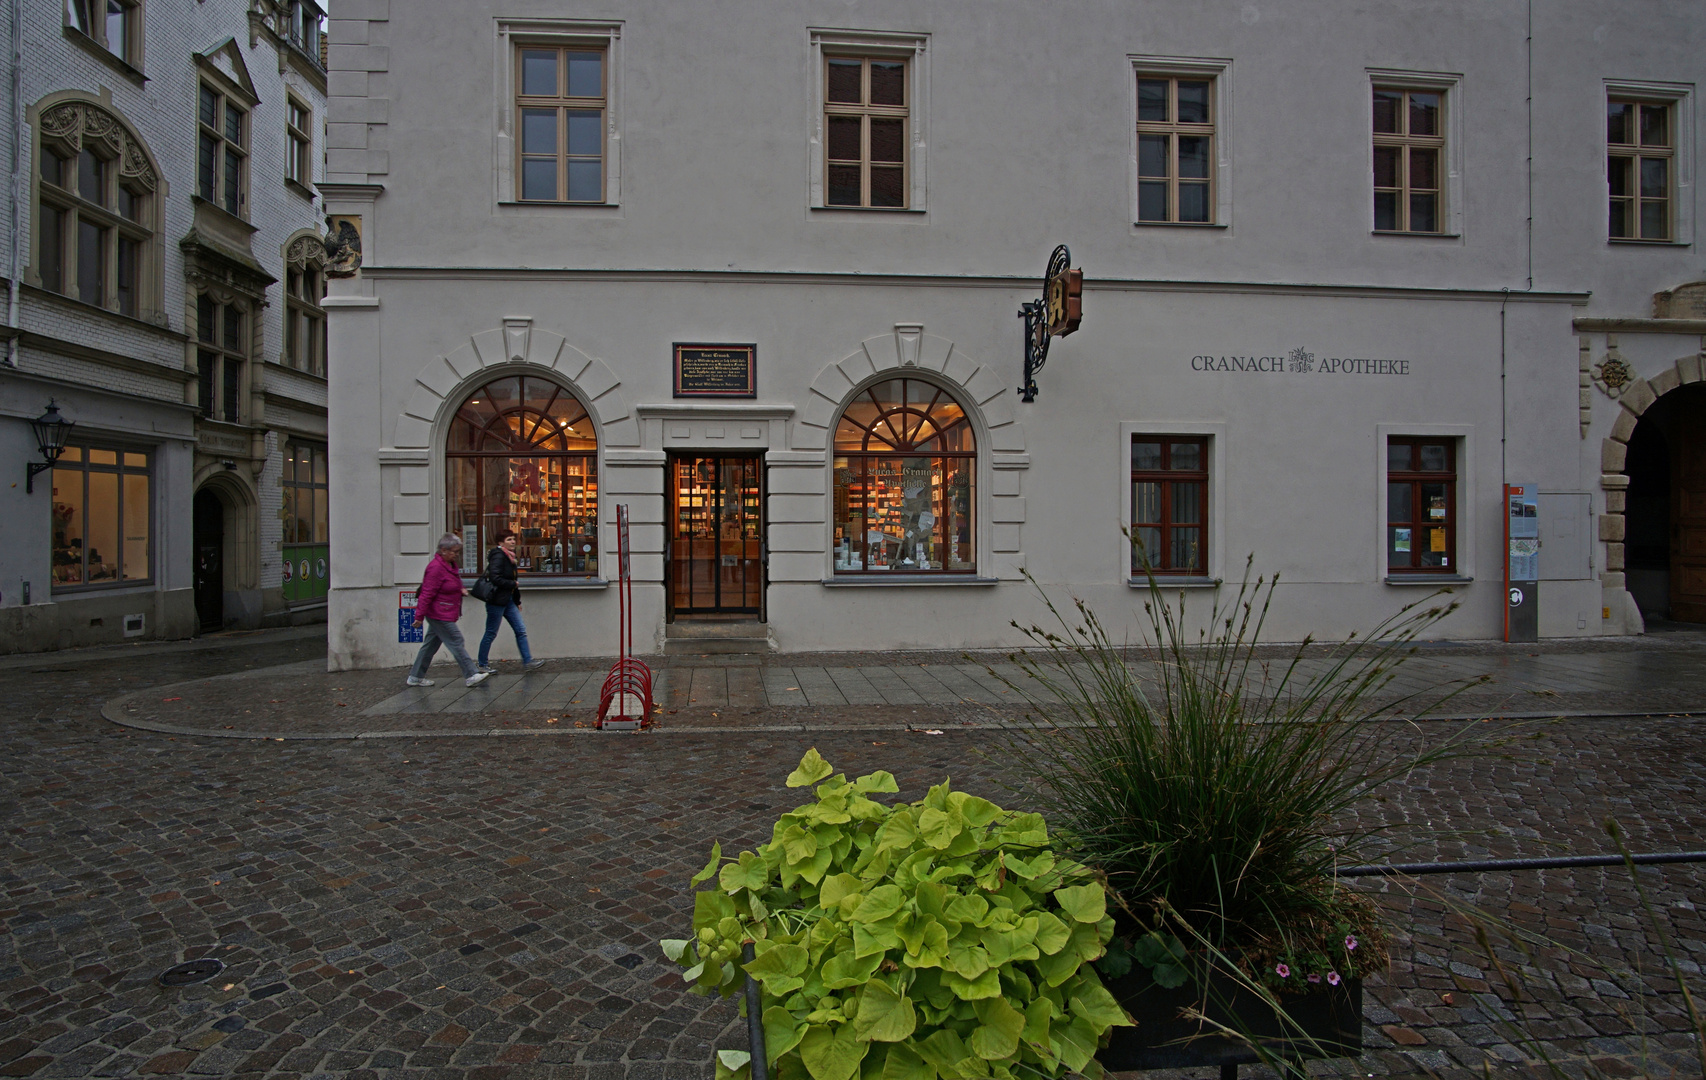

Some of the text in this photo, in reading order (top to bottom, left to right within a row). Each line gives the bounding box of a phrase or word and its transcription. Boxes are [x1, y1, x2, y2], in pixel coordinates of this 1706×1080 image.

[1191, 355, 1410, 376] CRANACH APOTHEKE
[867, 467, 940, 477] Lucas Cranach
[883, 479, 927, 489] Apotheke
